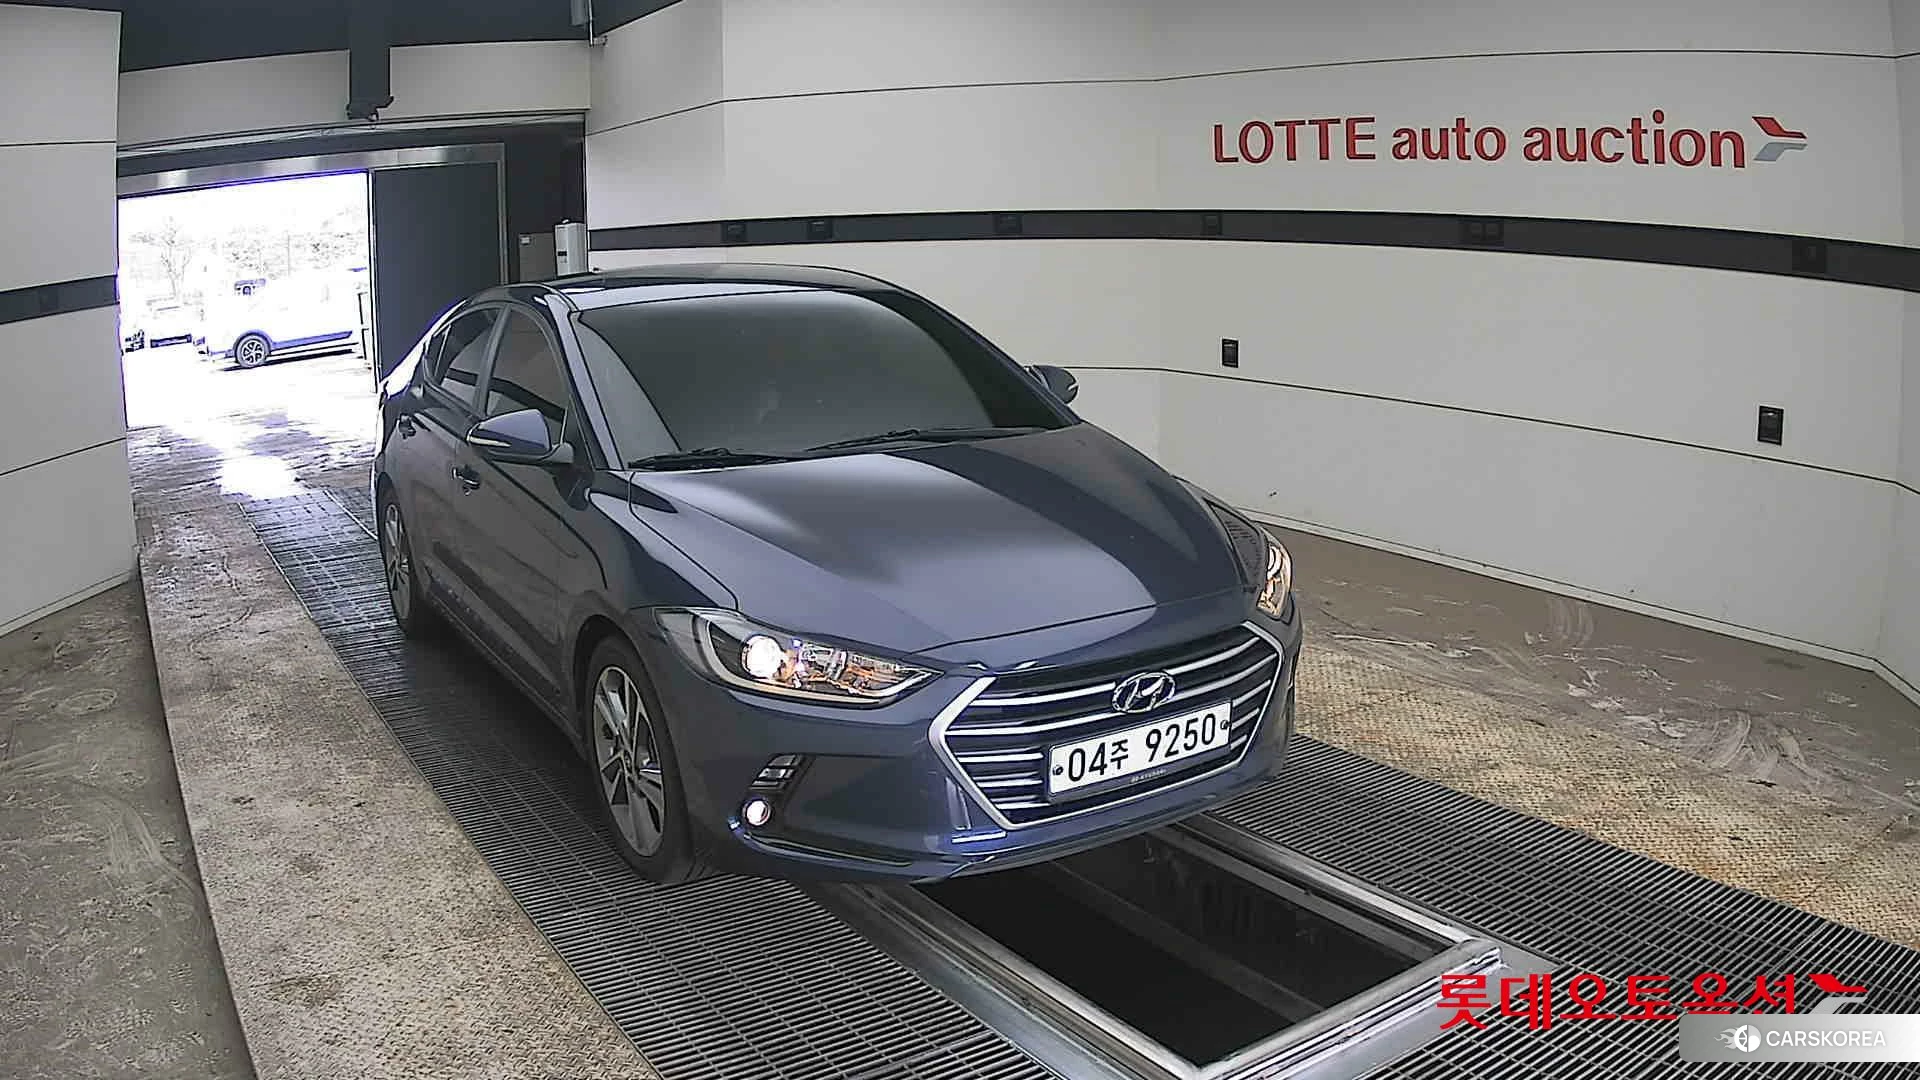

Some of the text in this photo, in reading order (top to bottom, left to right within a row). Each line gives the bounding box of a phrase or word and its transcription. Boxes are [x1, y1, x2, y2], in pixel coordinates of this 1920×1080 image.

[1213, 109, 1746, 169] LOTTE auto auction
[1067, 713, 1216, 782] 04주 9250
